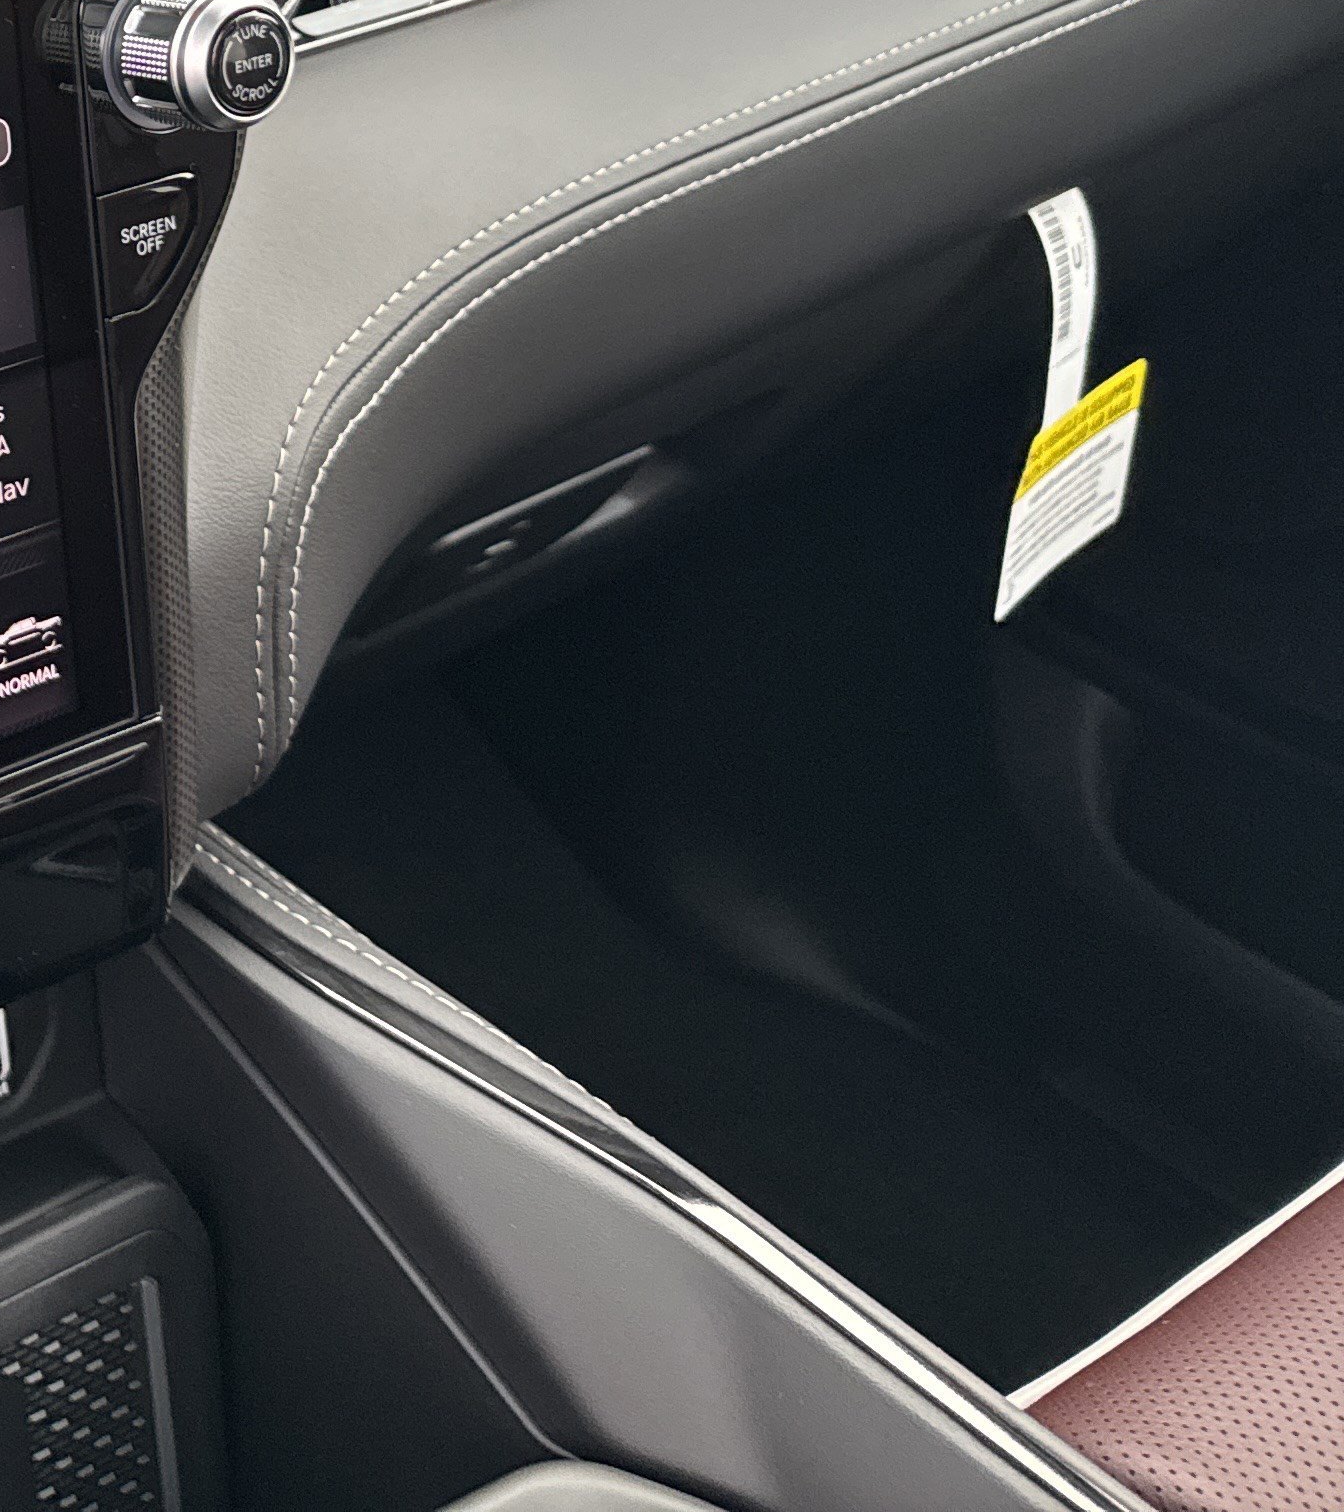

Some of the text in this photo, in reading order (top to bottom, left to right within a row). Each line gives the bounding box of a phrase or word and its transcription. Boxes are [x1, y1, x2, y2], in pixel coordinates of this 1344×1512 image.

[232, 24, 267, 44] TUNE
[234, 52, 273, 73] ENTER
[232, 76, 279, 102] SCROLL
[120, 215, 176, 245] SCREEN
[136, 236, 165, 256] OFF
